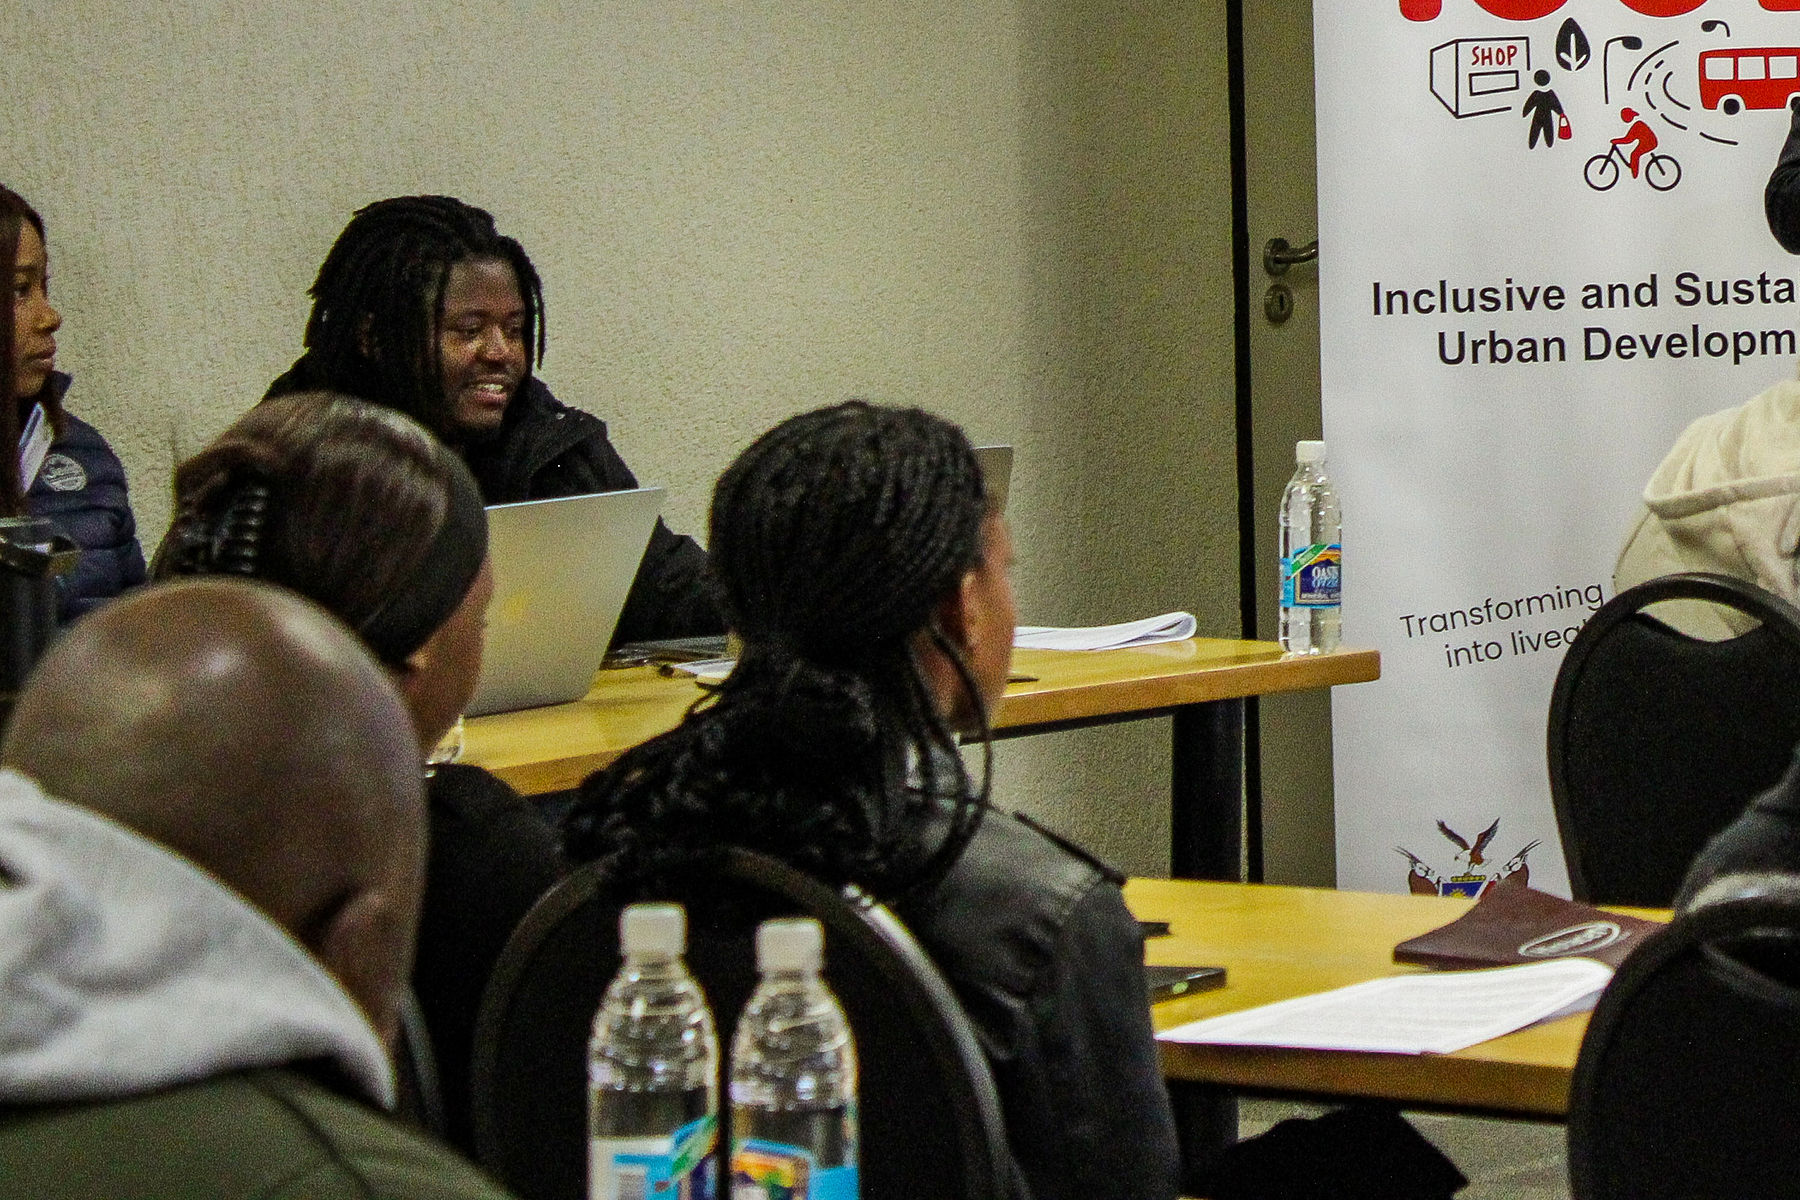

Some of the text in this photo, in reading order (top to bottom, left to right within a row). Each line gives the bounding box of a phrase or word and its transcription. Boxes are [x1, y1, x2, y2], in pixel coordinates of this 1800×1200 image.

[1471, 45, 1518, 66] SHOP
[1372, 277, 1566, 316] Inclusive
[1581, 273, 1659, 310] and
[1438, 330, 1566, 365] Urban
[1400, 584, 1604, 639] Transforming
[1444, 618, 1587, 668] into livea
